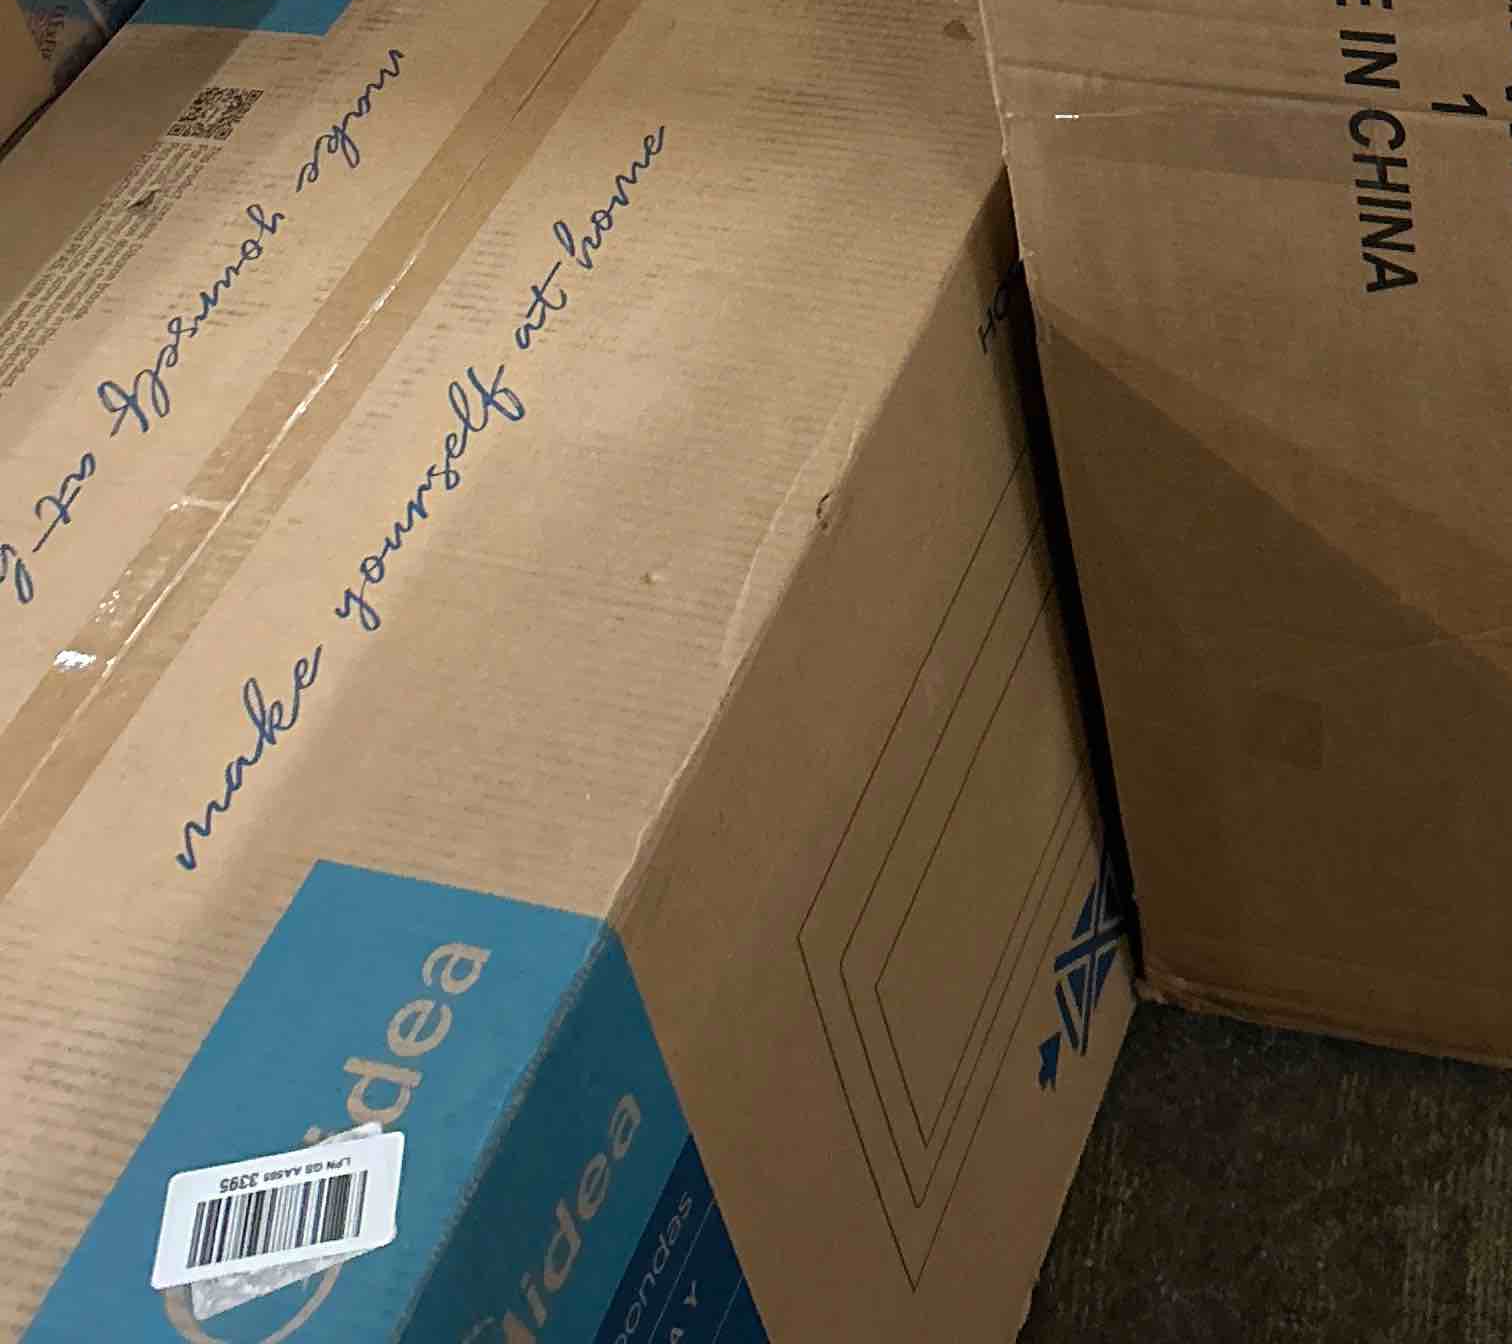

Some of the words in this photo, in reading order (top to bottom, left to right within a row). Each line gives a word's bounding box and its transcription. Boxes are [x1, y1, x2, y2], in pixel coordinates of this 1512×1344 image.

[297, 49, 405, 192] make
[1340, 30, 1401, 90] IN
[1432, 94, 1489, 118] 1
[1349, 109, 1420, 294] CHINA
[97, 203, 284, 437] yourself
[33, 453, 96, 552] at
[177, 645, 322, 870] make
[336, 365, 525, 631] yourself
[515, 262, 569, 350] at
[553, 126, 666, 271] home
[304, 942, 491, 1146] dea
[220, 1173, 259, 1193] 3395
